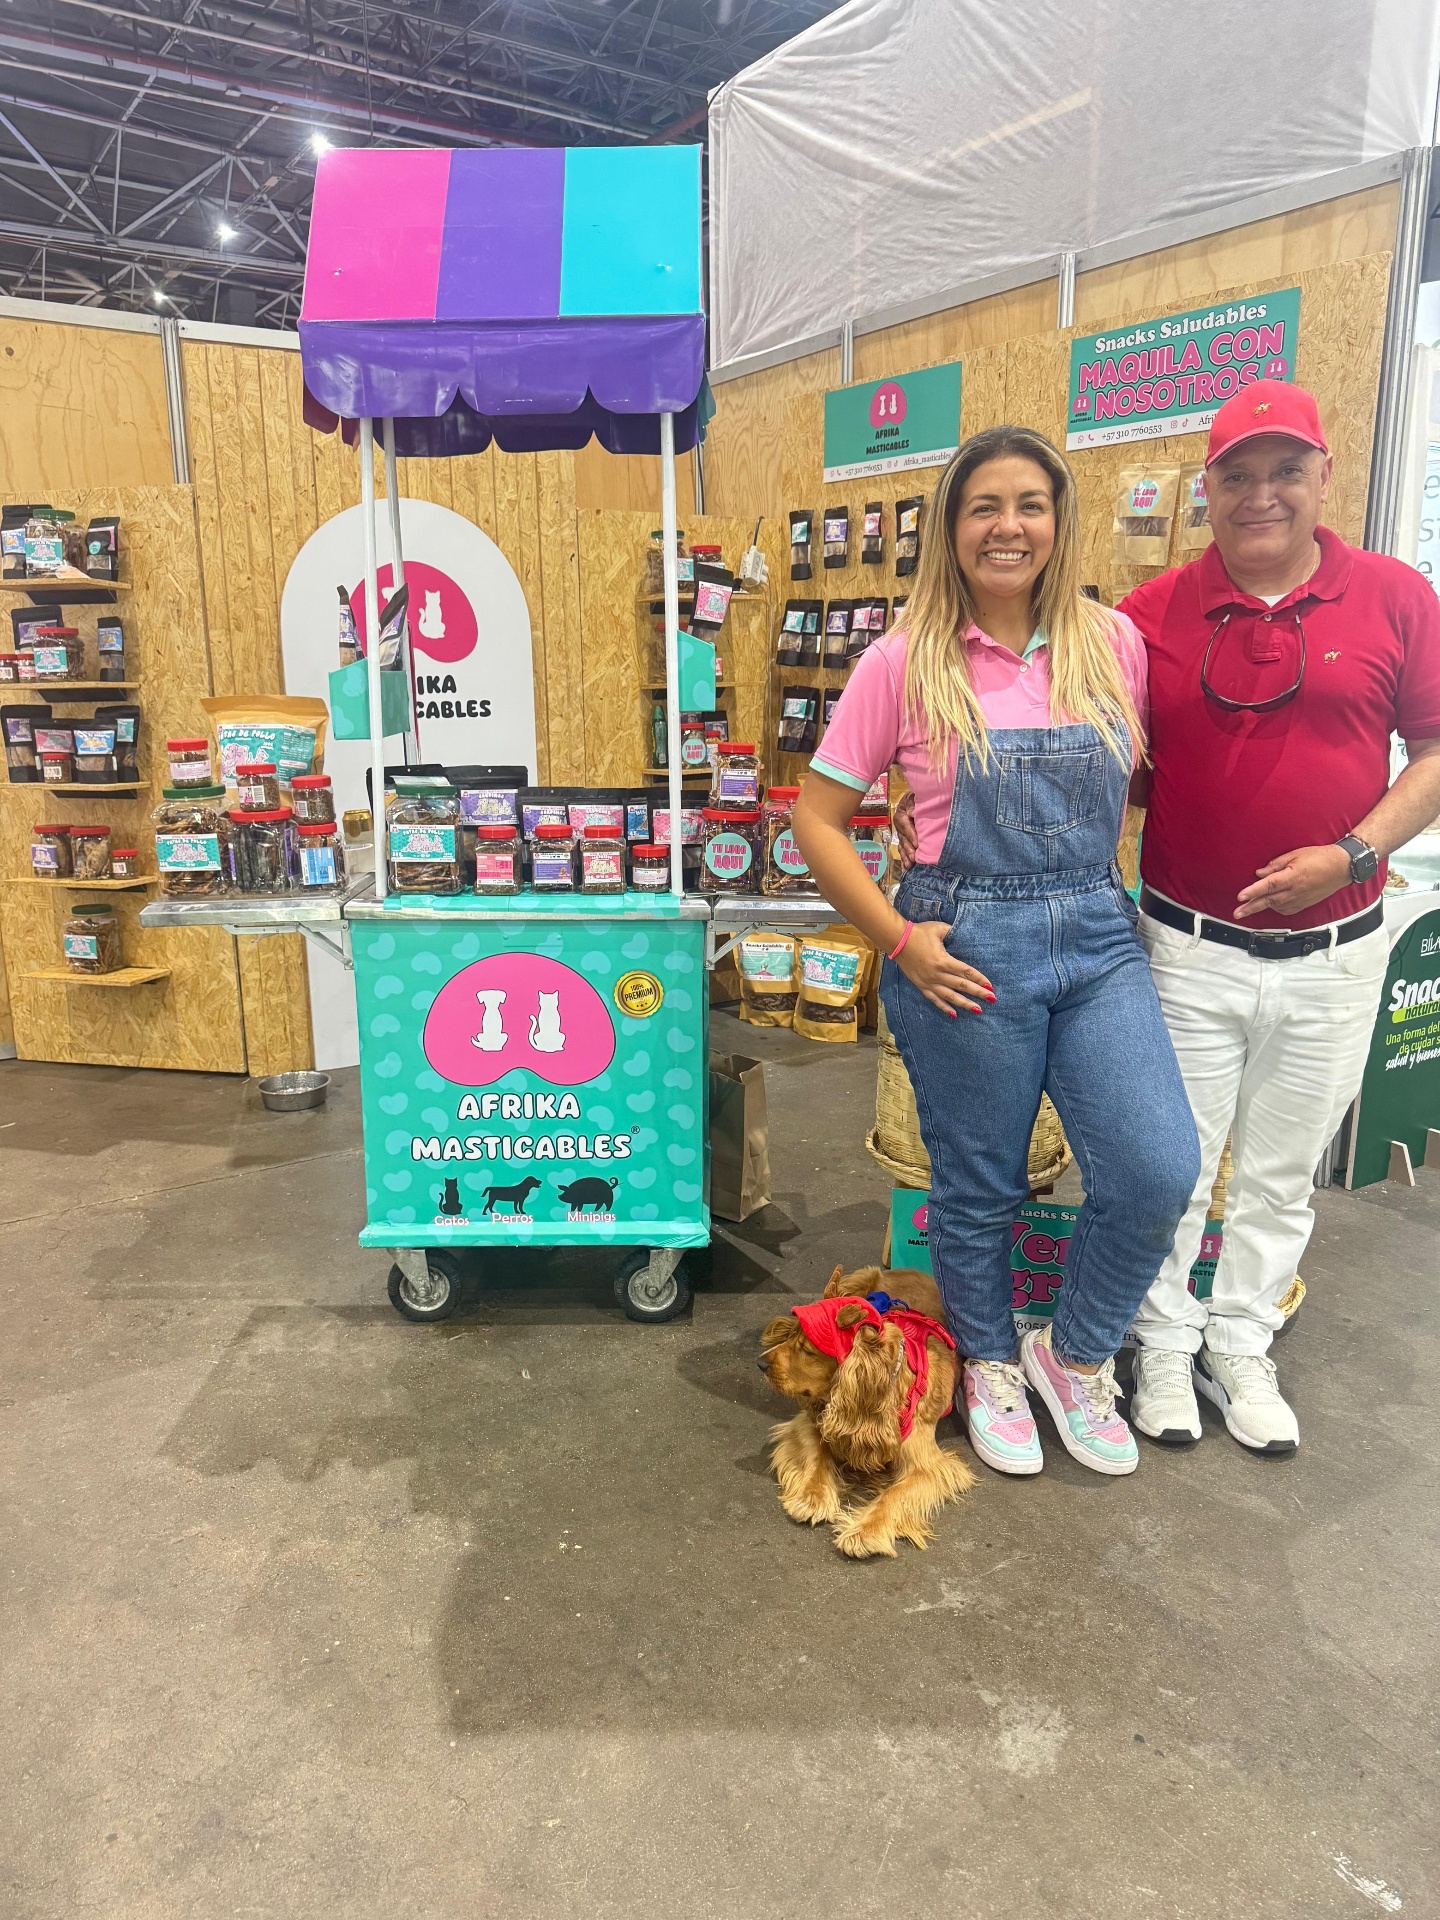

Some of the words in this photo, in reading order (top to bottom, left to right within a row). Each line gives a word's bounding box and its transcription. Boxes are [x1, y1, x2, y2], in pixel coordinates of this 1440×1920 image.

[1095, 327, 1156, 354] Snacks
[1160, 303, 1267, 339] Saludables
[1078, 339, 1202, 393] MAQUILA
[1208, 320, 1286, 366] CON
[1093, 361, 1260, 421] NOSOTROS
[1198, 413, 1217, 426] Afri
[875, 427, 899, 440] AFRIKA
[1101, 432, 1117, 441] +57
[1116, 430, 1129, 440] 310
[1130, 424, 1163, 437] 7760553
[865, 439, 909, 455] MASTICABLES
[1132, 496, 1154, 509] AQUI
[416, 674, 457, 695] IKA
[416, 699, 492, 719] CABLES
[711, 843, 723, 854] TU
[724, 844, 747, 855] LOGO
[779, 838, 792, 849] TU
[713, 854, 744, 870] AQUI
[780, 850, 806, 866] AQU
[624, 987, 654, 1002] PREMIUM
[1388, 977, 1440, 1012] Snac
[1404, 1000, 1440, 1020] natura
[1385, 1033, 1402, 1046] Una
[1402, 1026, 1426, 1042] forma
[1399, 1042, 1409, 1055] de
[1410, 1035, 1436, 1052] cuidar
[457, 1092, 581, 1120] AFRIKA
[433, 1215, 470, 1226] Gatos
[491, 1212, 534, 1225] Perros
[566, 1211, 616, 1224] Minipigs
[908, 1239, 929, 1247] MAST
[1197, 1261, 1217, 1269] AFRI
